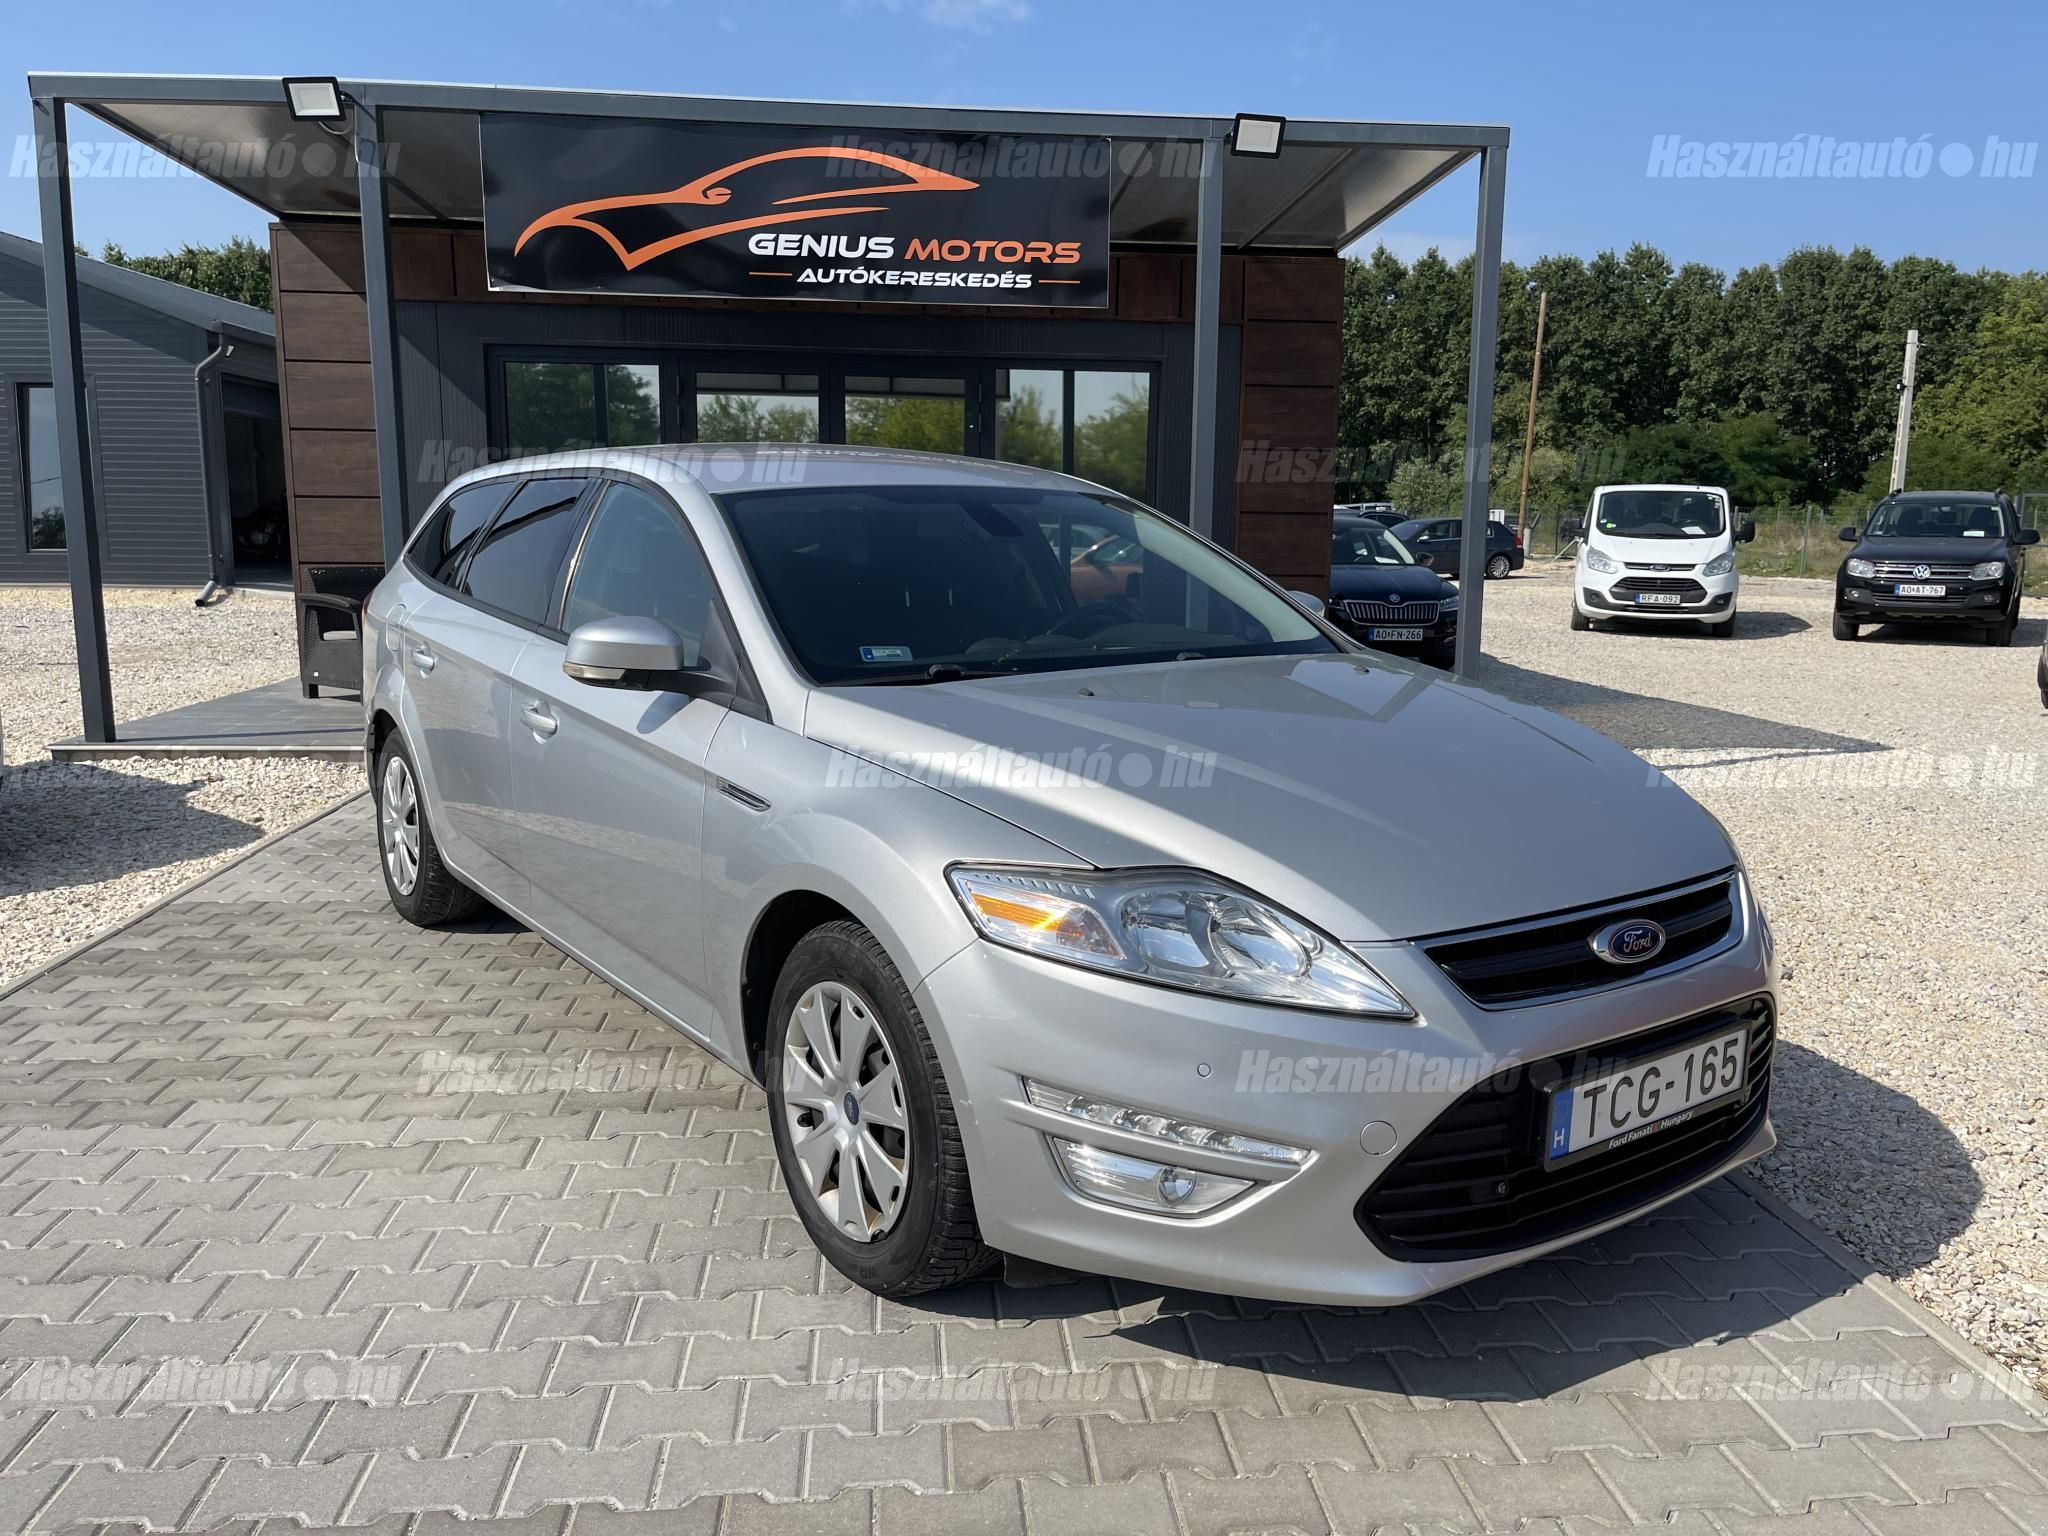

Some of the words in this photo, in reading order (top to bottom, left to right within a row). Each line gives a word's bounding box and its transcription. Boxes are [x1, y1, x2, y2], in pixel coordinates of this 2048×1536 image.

[748, 232, 896, 259] GENIUS
[903, 238, 1082, 264] MOTORS
[797, 265, 1033, 289] AUTÓKERESKEDÉS
[1623, 929, 1653, 953] Ford
[1583, 1037, 1739, 1139] TCG-165
